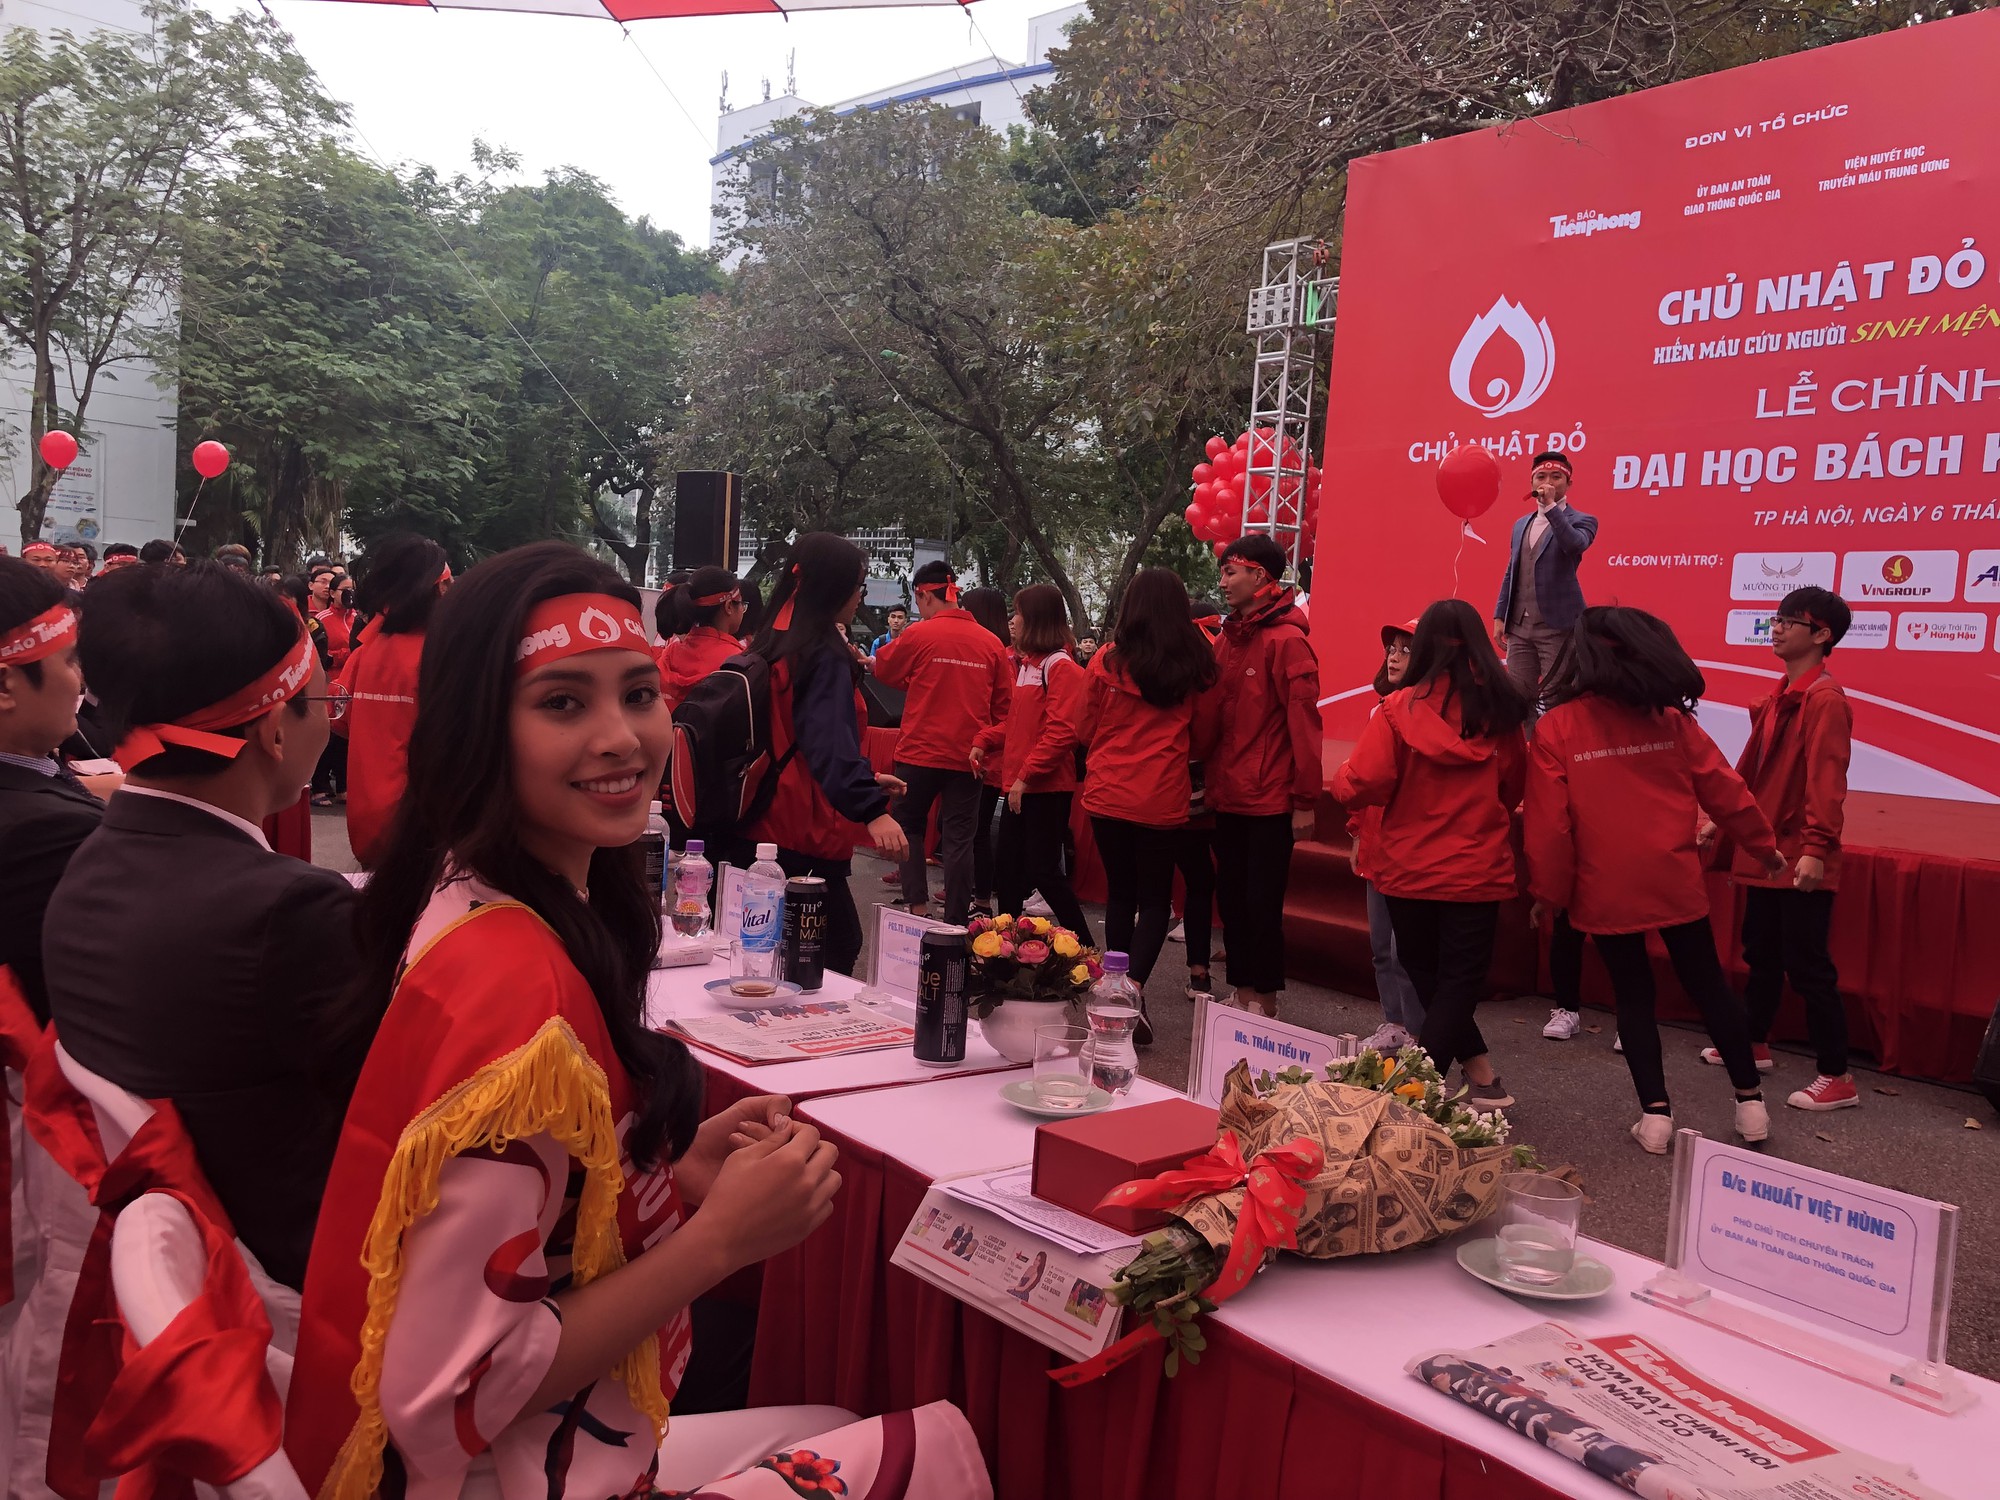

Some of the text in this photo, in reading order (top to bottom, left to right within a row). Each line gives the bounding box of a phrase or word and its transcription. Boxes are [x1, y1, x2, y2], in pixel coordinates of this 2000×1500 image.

[1685, 104, 1849, 149] ĐƠN VỊ TỔ CHỨC
[1845, 145, 1925, 170] VIỆN HUYẾT HỌC
[1710, 181, 1730, 196] BAN
[1731, 178, 1746, 192] AN
[1747, 174, 1771, 190] TOÀN
[1818, 158, 1950, 192] TRUYỀN MÁU TRUNG ƯƠNG
[1683, 188, 1781, 216] GIAO THÔNG QUỐC GIA
[1658, 237, 1986, 326] CHỦ NHẬT ĐỎ
[1653, 324, 1847, 364] HIẾN MÁU CỨU NGƯỜI
[1850, 315, 1930, 344] SINH
[1755, 371, 1818, 419] LỄ
[1547, 421, 1587, 453] ĐỎ
[1613, 452, 1687, 496] ĐẠI
[1700, 446, 1797, 492] HỌC
[1814, 432, 1964, 481] BÁCH
[1754, 511, 1777, 527] TP
[1782, 505, 1808, 526] HÀ
[1815, 505, 1855, 527] NỘI,
[1862, 505, 1925, 525] NGÀY
[1930, 505, 1944, 521] 6
[1608, 554, 1631, 567] CÁC
[1632, 555, 1655, 567] ĐƠN
[1655, 555, 1671, 569] VỊ
[1674, 553, 1694, 566] TÀI
[1696, 555, 1718, 568] TRỢ
[1743, 583, 1779, 592] MƯỜNG
[1862, 583, 1931, 596] VINGROUP
[1930, 631, 1976, 642] Hùng Hậu
[742, 906, 771, 928] Vital
[800, 913, 828, 928] true
[1235, 1030, 1249, 1046] Ms.
[1277, 1041, 1297, 1060] TIỂU
[1299, 1049, 1311, 1064] VY
[1722, 1170, 1895, 1241] Đ/c KHUẤT VIỆT HÙNG
[1754, 1223, 1774, 1235] CHỦ
[1775, 1230, 1797, 1244] TỊCH
[1799, 1238, 1838, 1257] CHUYÊN
[1841, 1251, 1874, 1269] TRÁCH
[1725, 1230, 1743, 1242] BAN
[1745, 1237, 1758, 1248] AN
[1787, 1251, 1810, 1265] GIAO
[1879, 1282, 1896, 1295] GIA
[1629, 1385, 1678, 1410] NAY
